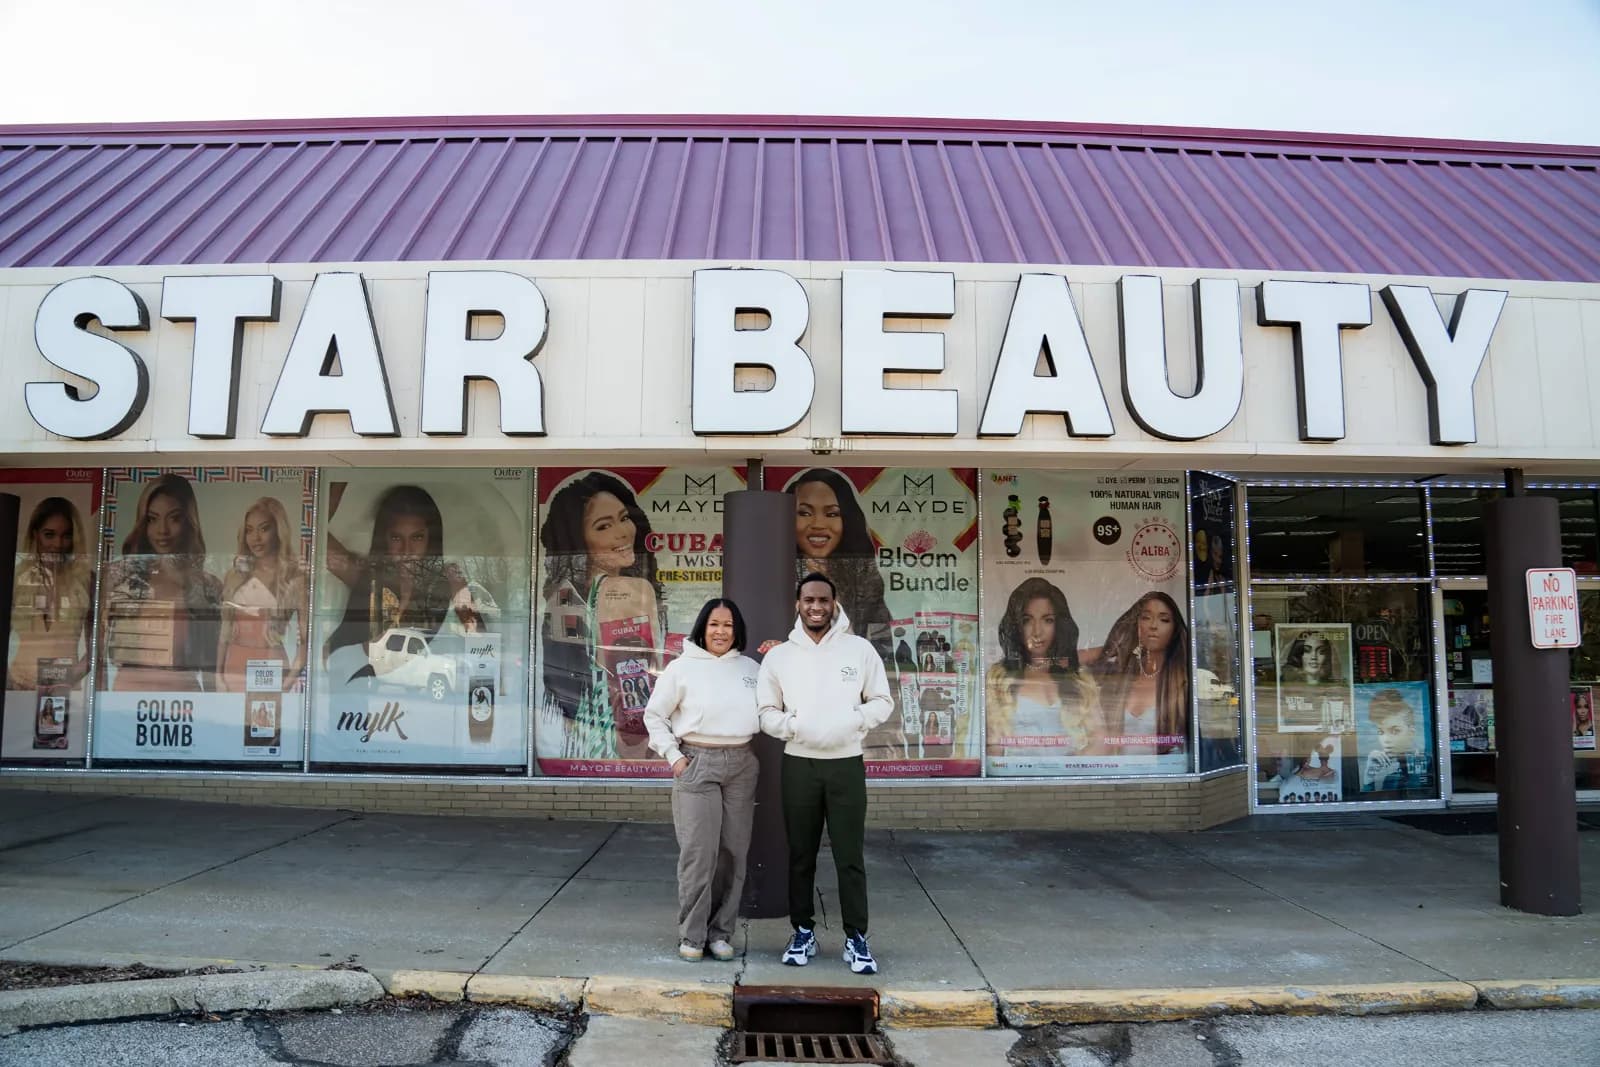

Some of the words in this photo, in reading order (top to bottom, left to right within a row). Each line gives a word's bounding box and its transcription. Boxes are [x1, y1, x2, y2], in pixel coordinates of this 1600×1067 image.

[25, 271, 547, 440] STAR
[692, 267, 1508, 445] BEAUTY
[494, 467, 521, 477] Outre
[1090, 490, 1113, 499] 100%
[1114, 490, 1151, 499] NATURAL
[1153, 490, 1180, 499] VIRGIN
[652, 500, 724, 513] MAYD
[872, 501, 964, 513] MAYDE
[1110, 501, 1140, 510] HUMAN
[1142, 501, 1161, 510] HAIR
[644, 532, 724, 553] CUBA
[879, 546, 957, 568] Bloom
[658, 570, 721, 582] PRE-STRETC
[890, 571, 969, 591] Bundle
[1543, 577, 1560, 592] NO
[1532, 596, 1574, 610] PARKING
[1545, 614, 1565, 624] FIRE
[1355, 624, 1389, 640] OPEN
[1545, 628, 1567, 638] LANE
[470, 644, 495, 657] mylk
[255, 670, 274, 678] COLOR
[137, 700, 193, 722] COLOR
[337, 702, 408, 743] mylk
[136, 724, 193, 747] BOMB
[570, 764, 612, 773] MAYDE
[615, 765, 649, 773] BEAUTY
[882, 765, 921, 773] AUTHORIZED
[921, 764, 943, 772] DEALER
